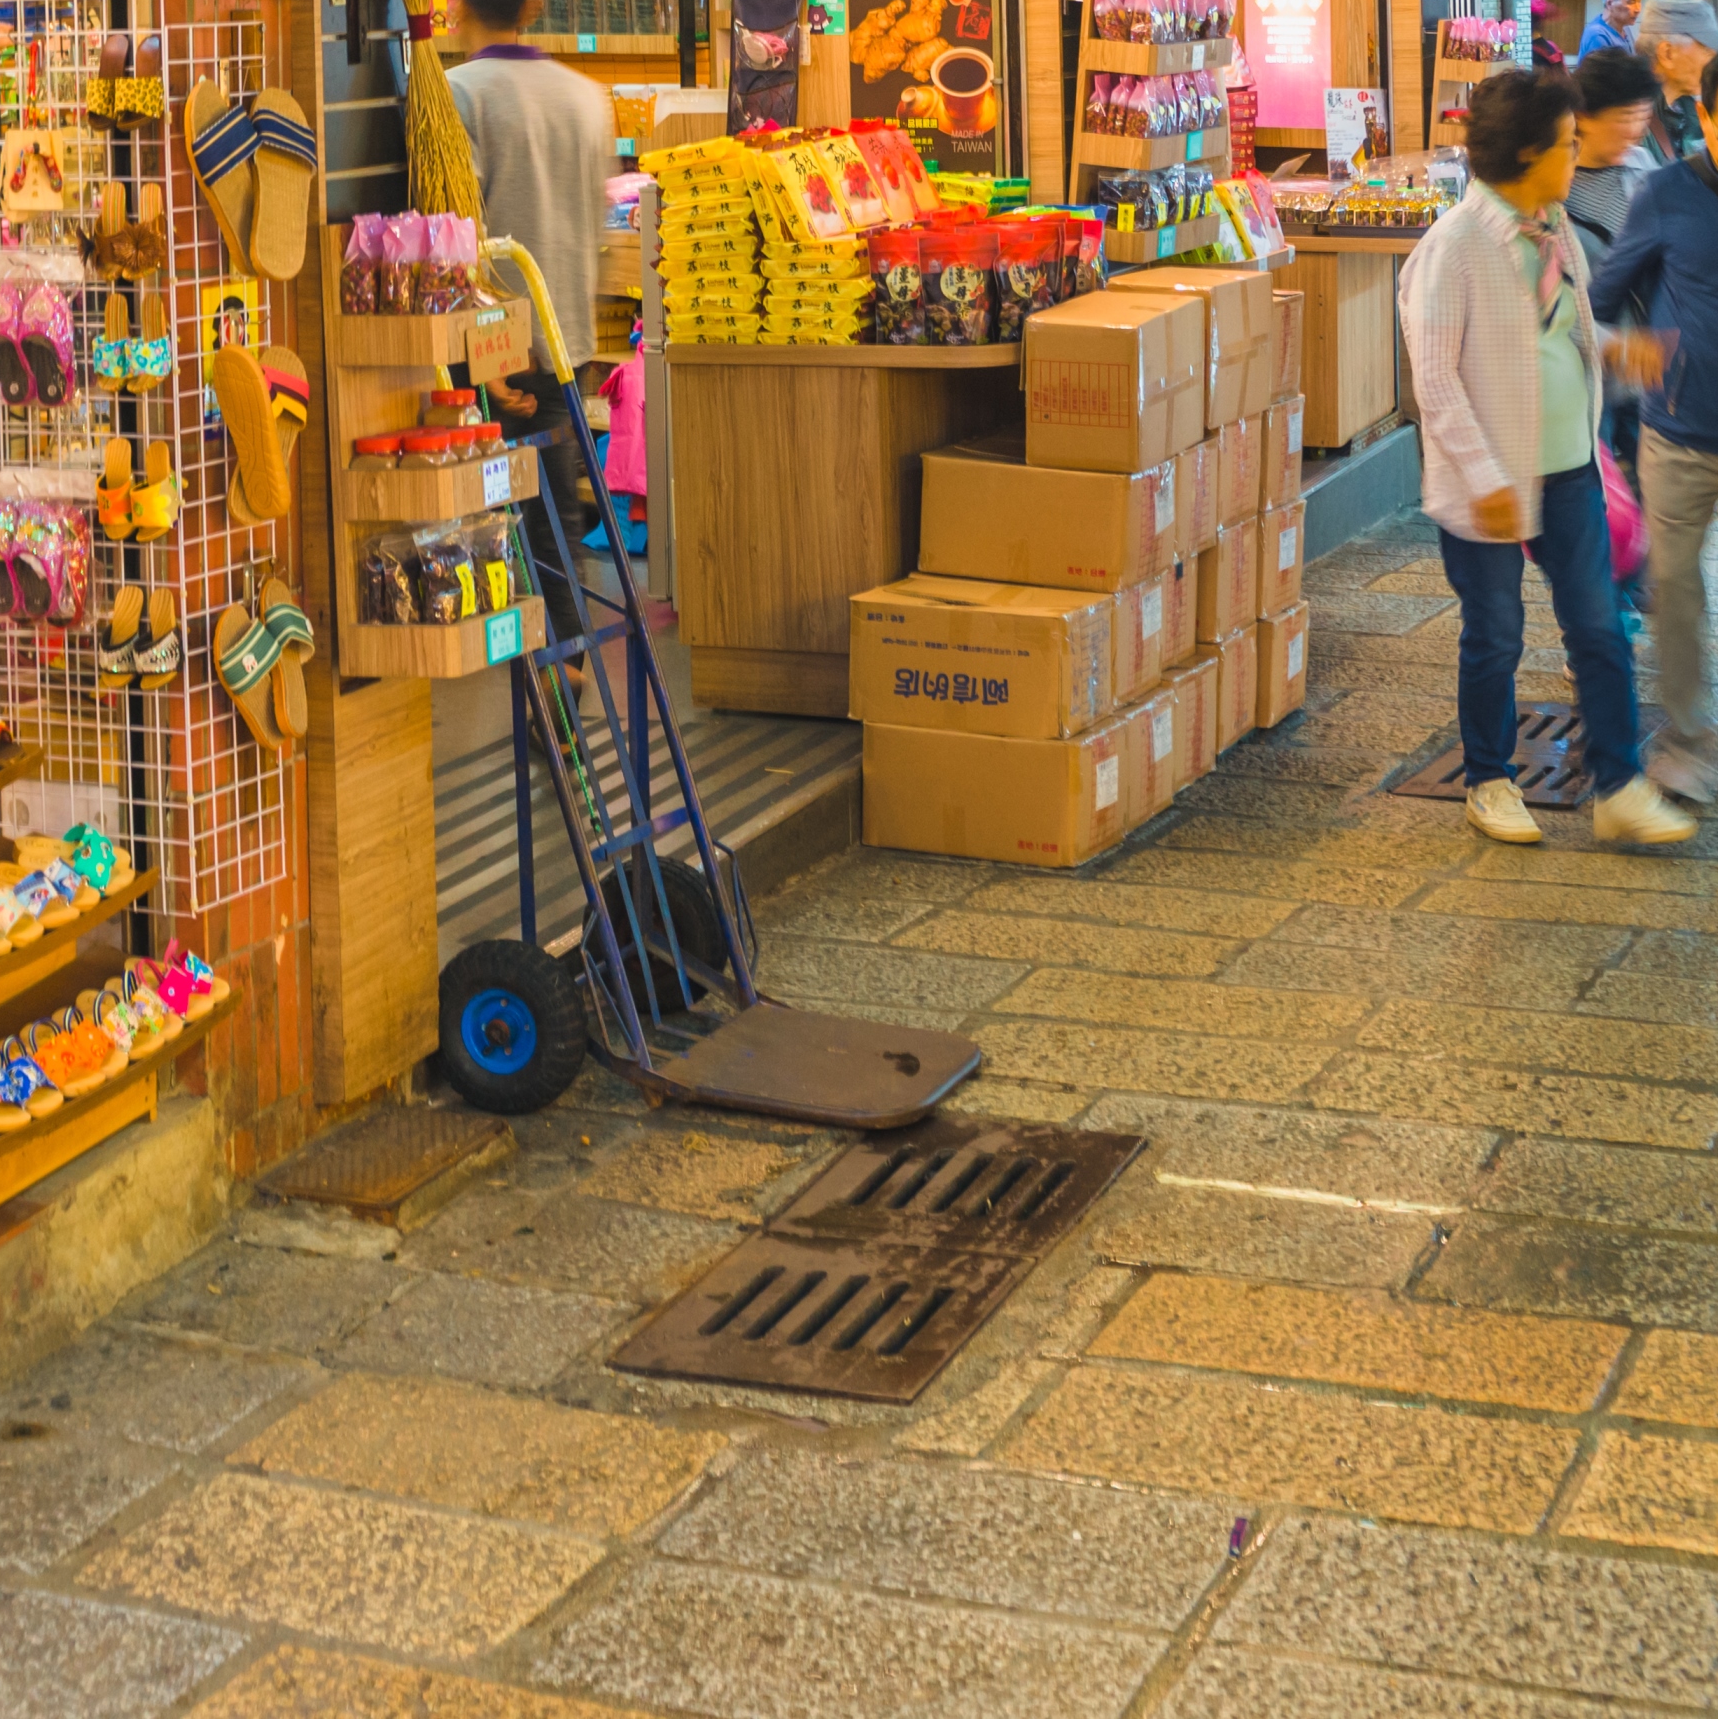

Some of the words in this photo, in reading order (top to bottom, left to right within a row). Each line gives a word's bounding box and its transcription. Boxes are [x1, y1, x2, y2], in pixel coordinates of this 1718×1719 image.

[951, 130, 973, 139] MADE
[975, 131, 984, 139] IN
[950, 141, 993, 153] TAIWAN
[894, 668, 1009, 705] 阿信的店
